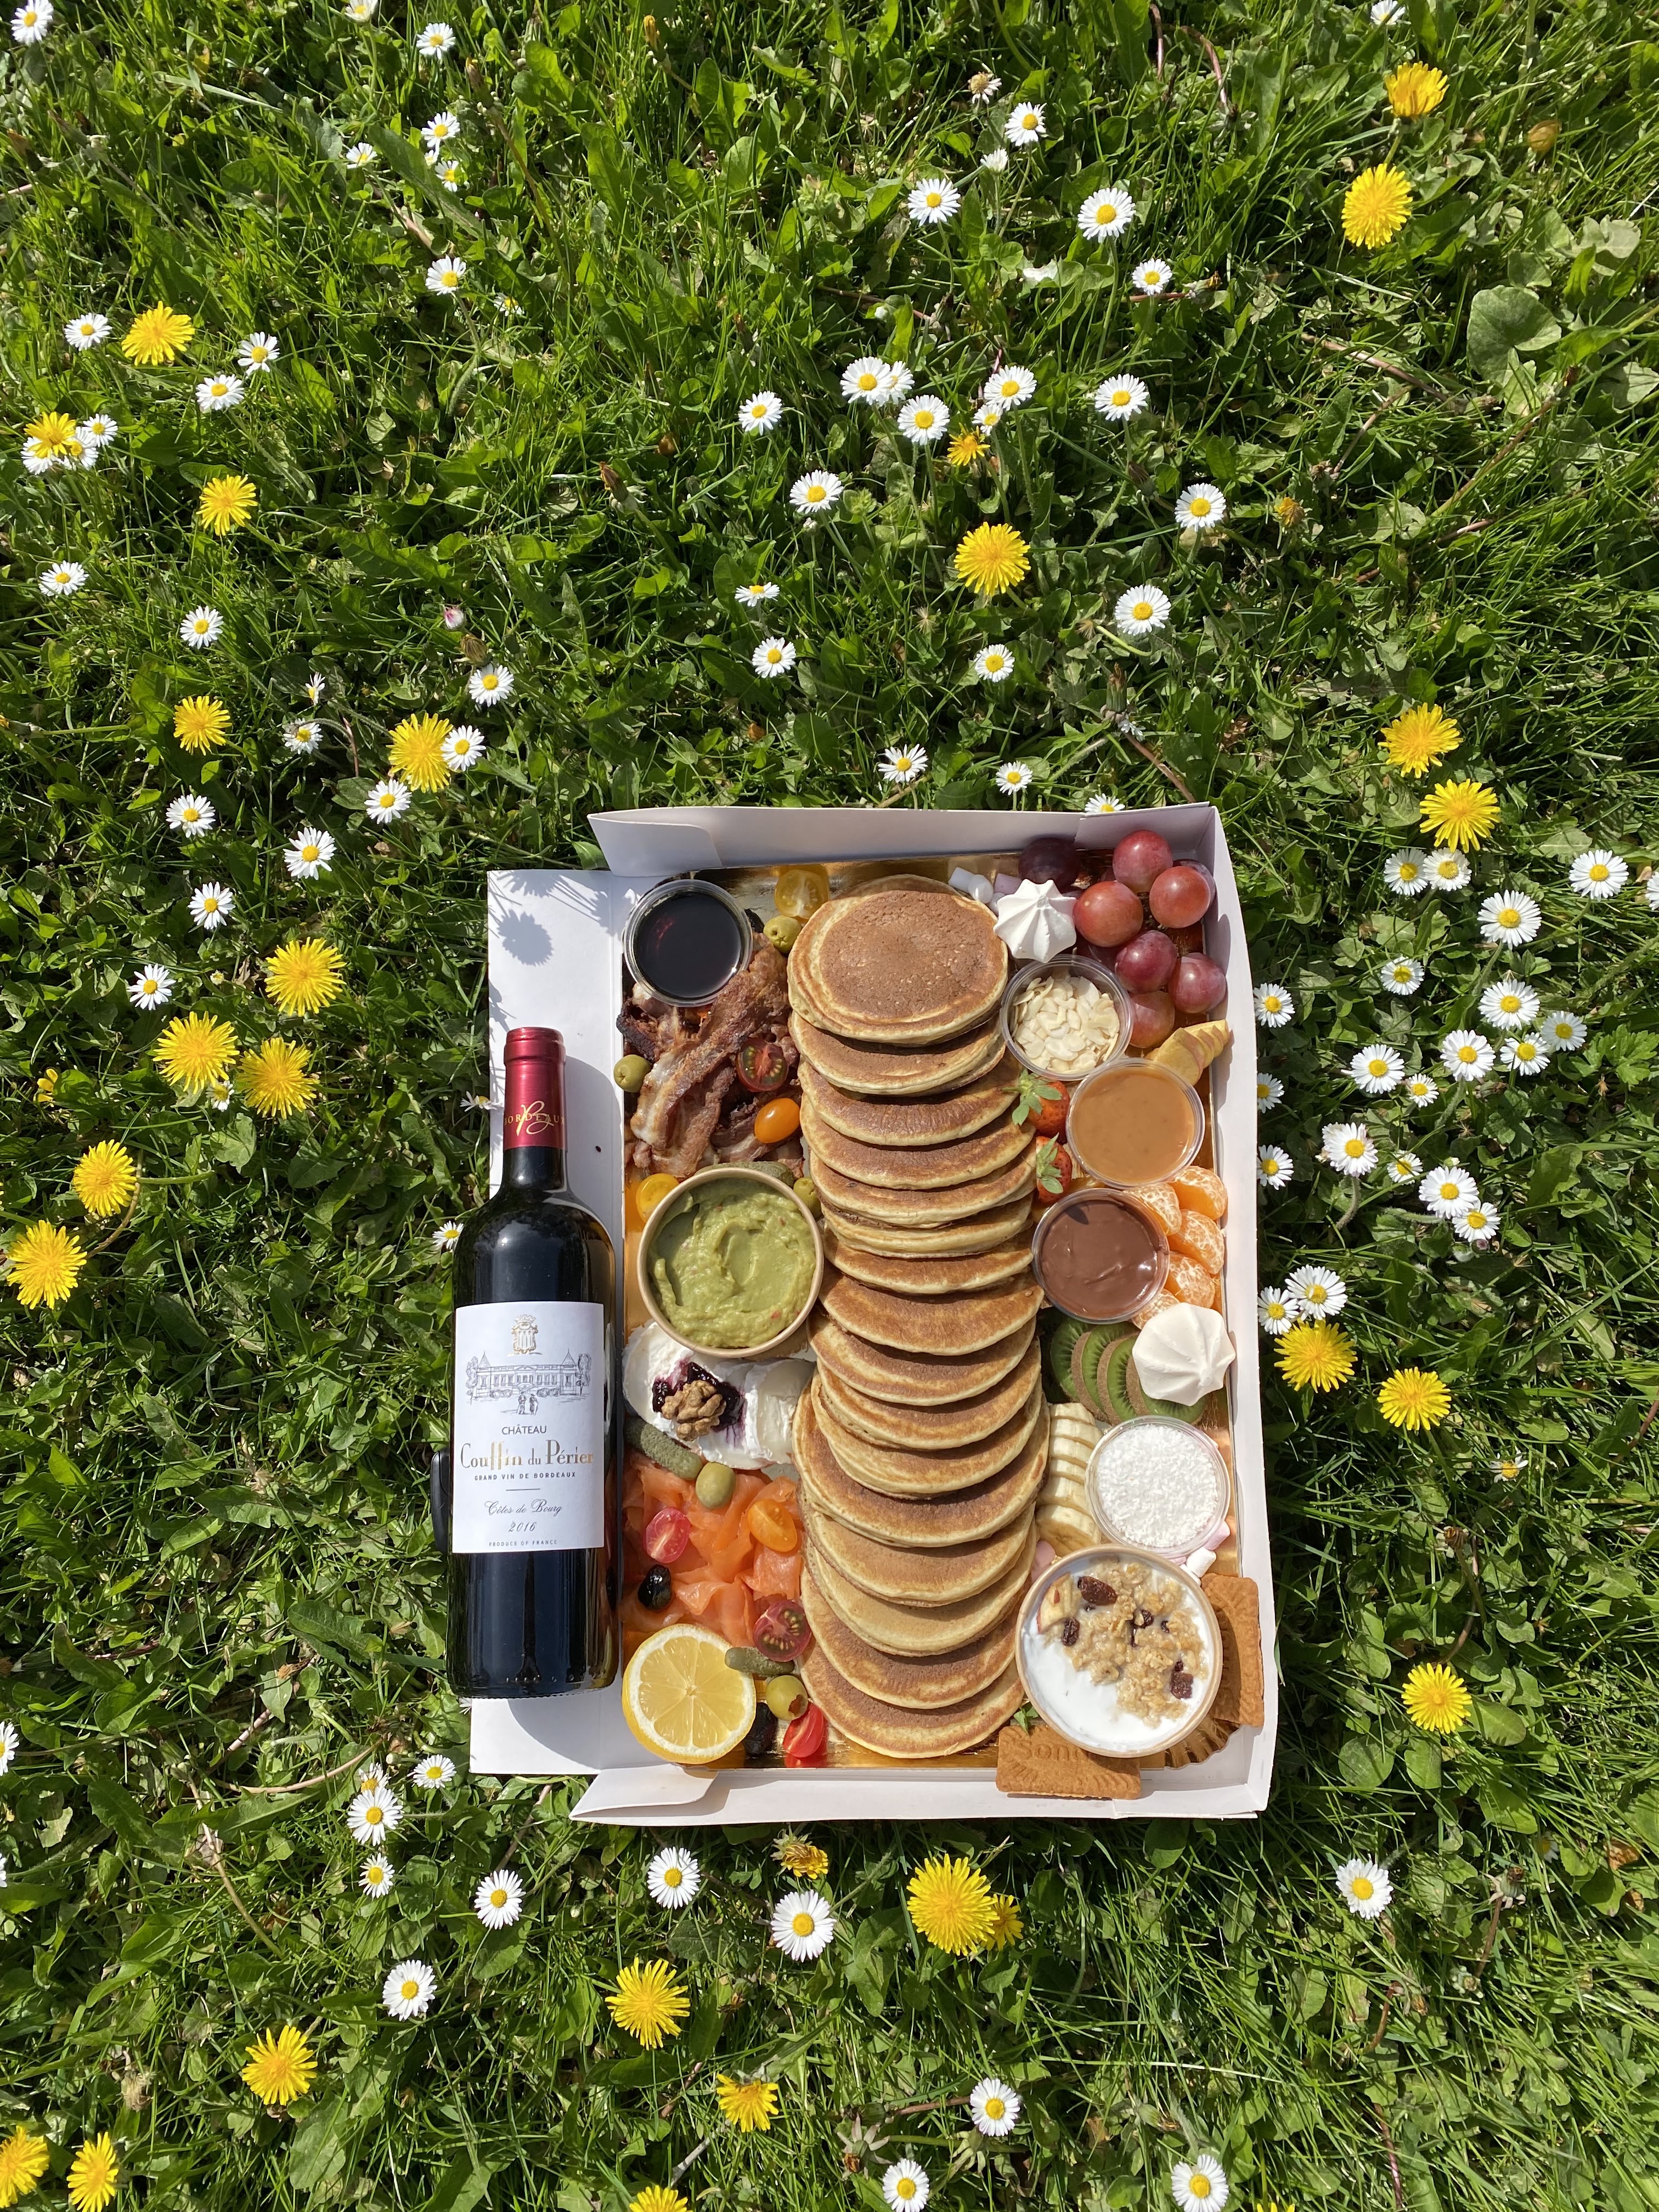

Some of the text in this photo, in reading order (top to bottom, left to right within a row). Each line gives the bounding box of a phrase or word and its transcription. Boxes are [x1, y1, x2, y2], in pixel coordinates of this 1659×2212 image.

[501, 1424, 547, 1435] CHÂTEAU
[460, 1439, 594, 1471] Couffin du Périer
[484, 1498, 563, 1517] Côtes de Bourg
[508, 1521, 537, 1533] 2016
